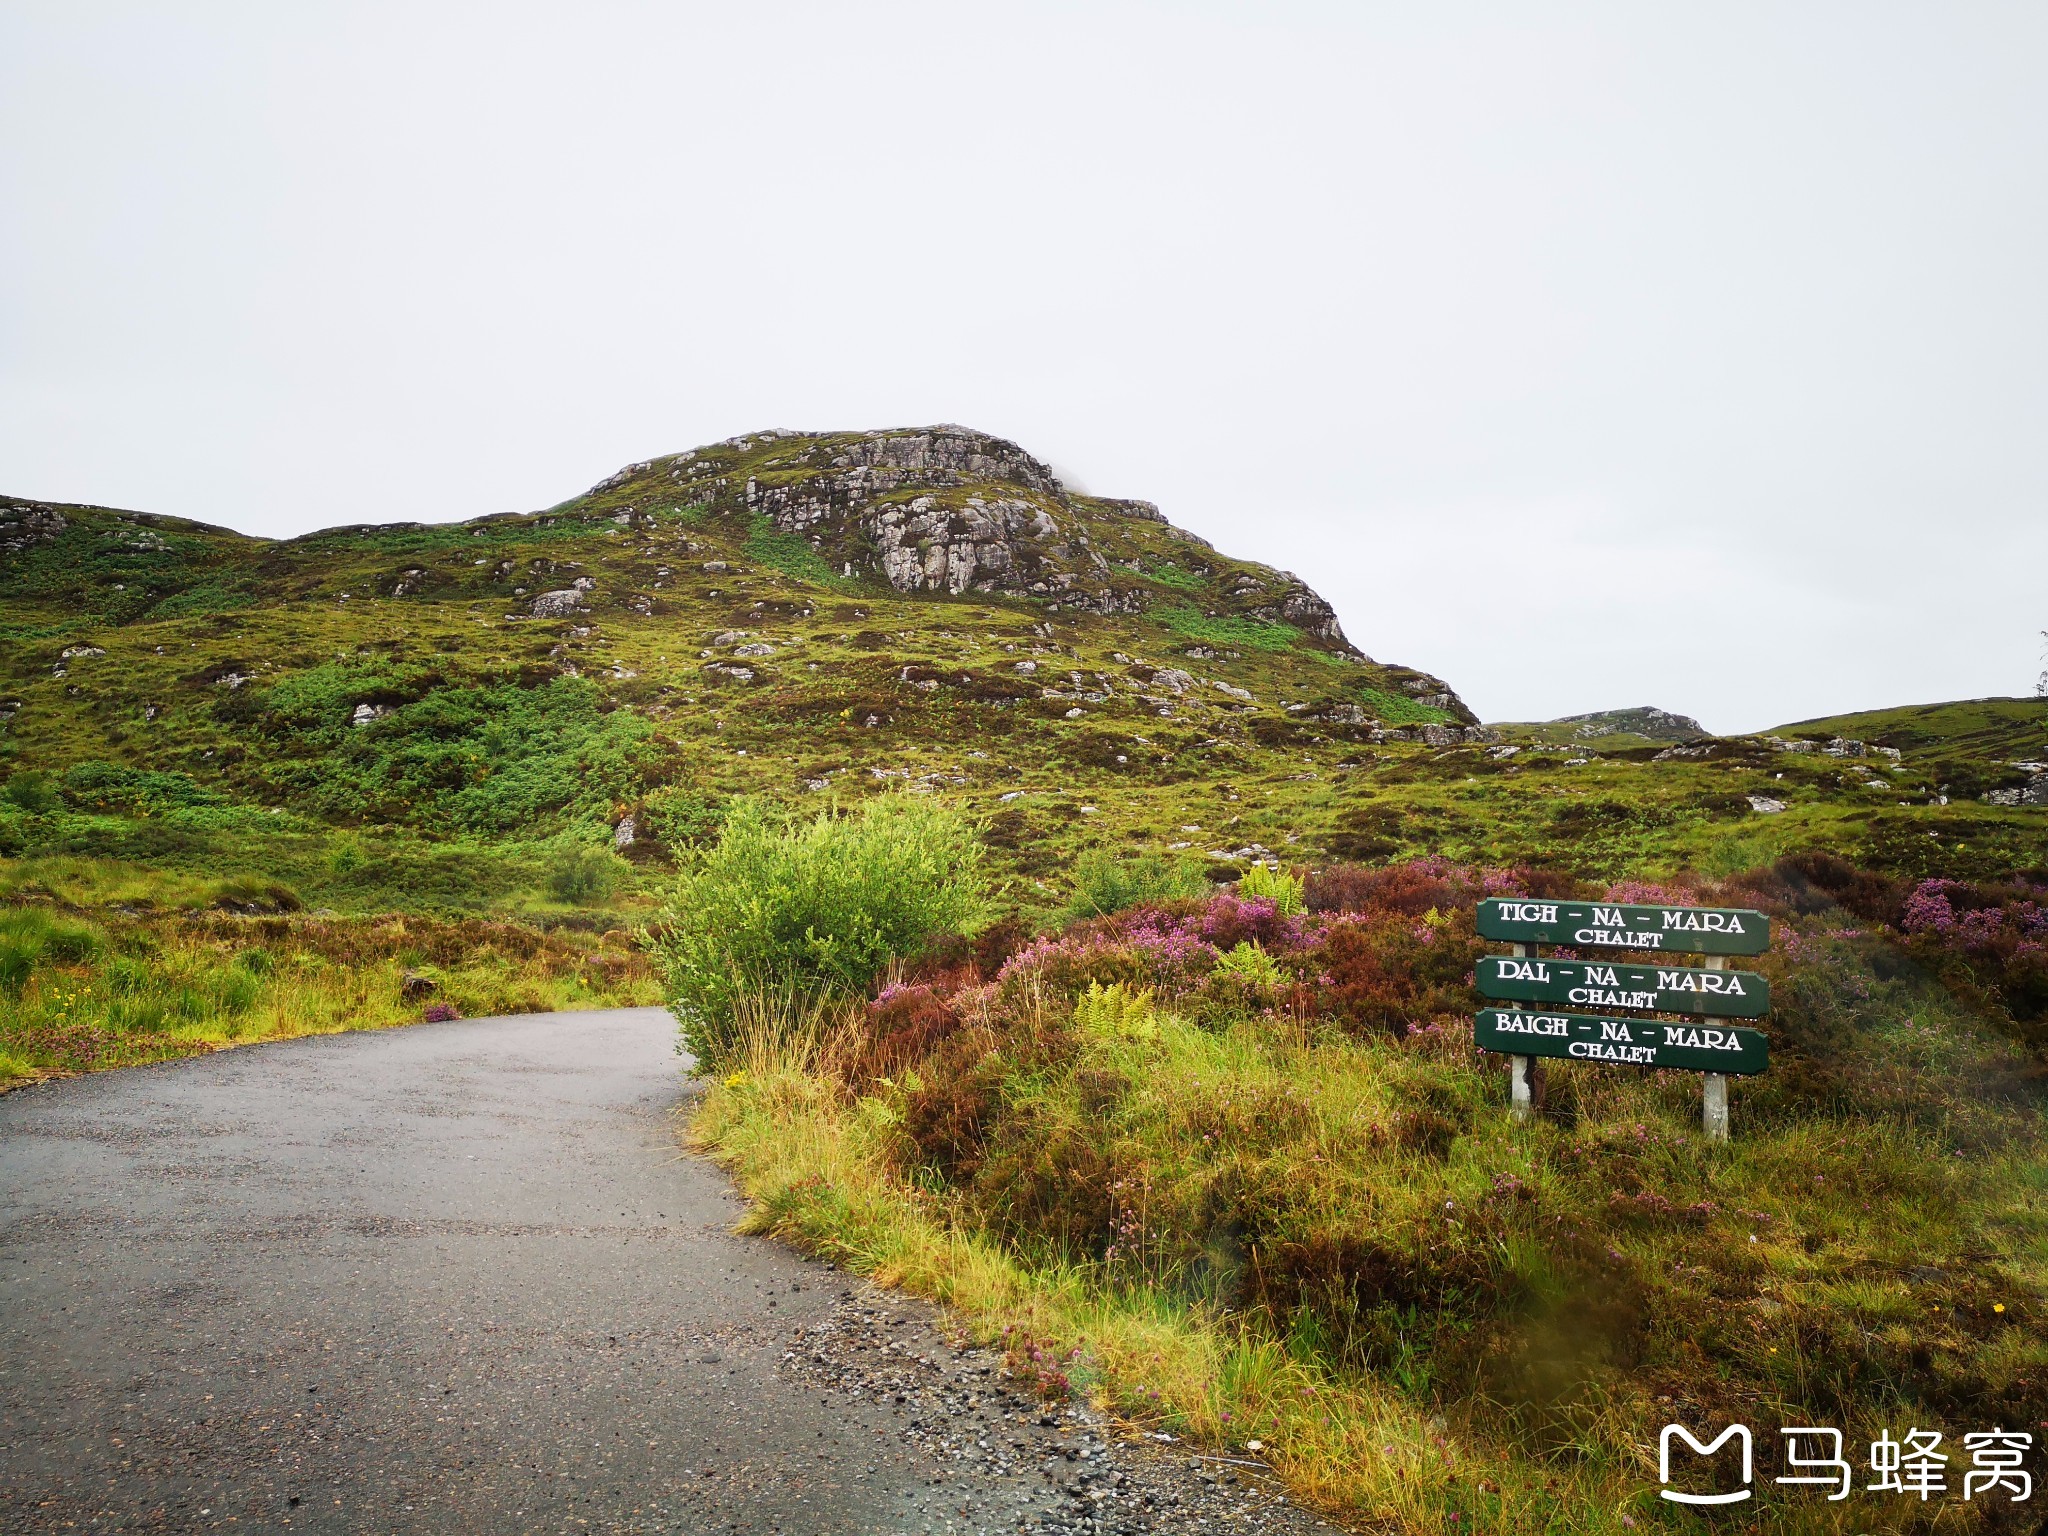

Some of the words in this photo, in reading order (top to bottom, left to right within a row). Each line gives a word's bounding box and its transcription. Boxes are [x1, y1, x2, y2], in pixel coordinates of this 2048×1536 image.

[1499, 902, 1559, 924] TIGH
[1592, 908, 1626, 927] NA
[1661, 911, 1745, 934] MARA
[1574, 929, 1663, 948] CHALET
[1497, 961, 1550, 983] DAL
[1585, 966, 1619, 986] NA
[1656, 971, 1747, 996] MARA
[1568, 988, 1658, 1008] CHALET
[1495, 1013, 1569, 1037] BAIGH
[1600, 1022, 1633, 1042] NA
[1663, 1027, 1743, 1051] MARA
[1568, 1042, 1657, 1064] CHALET
